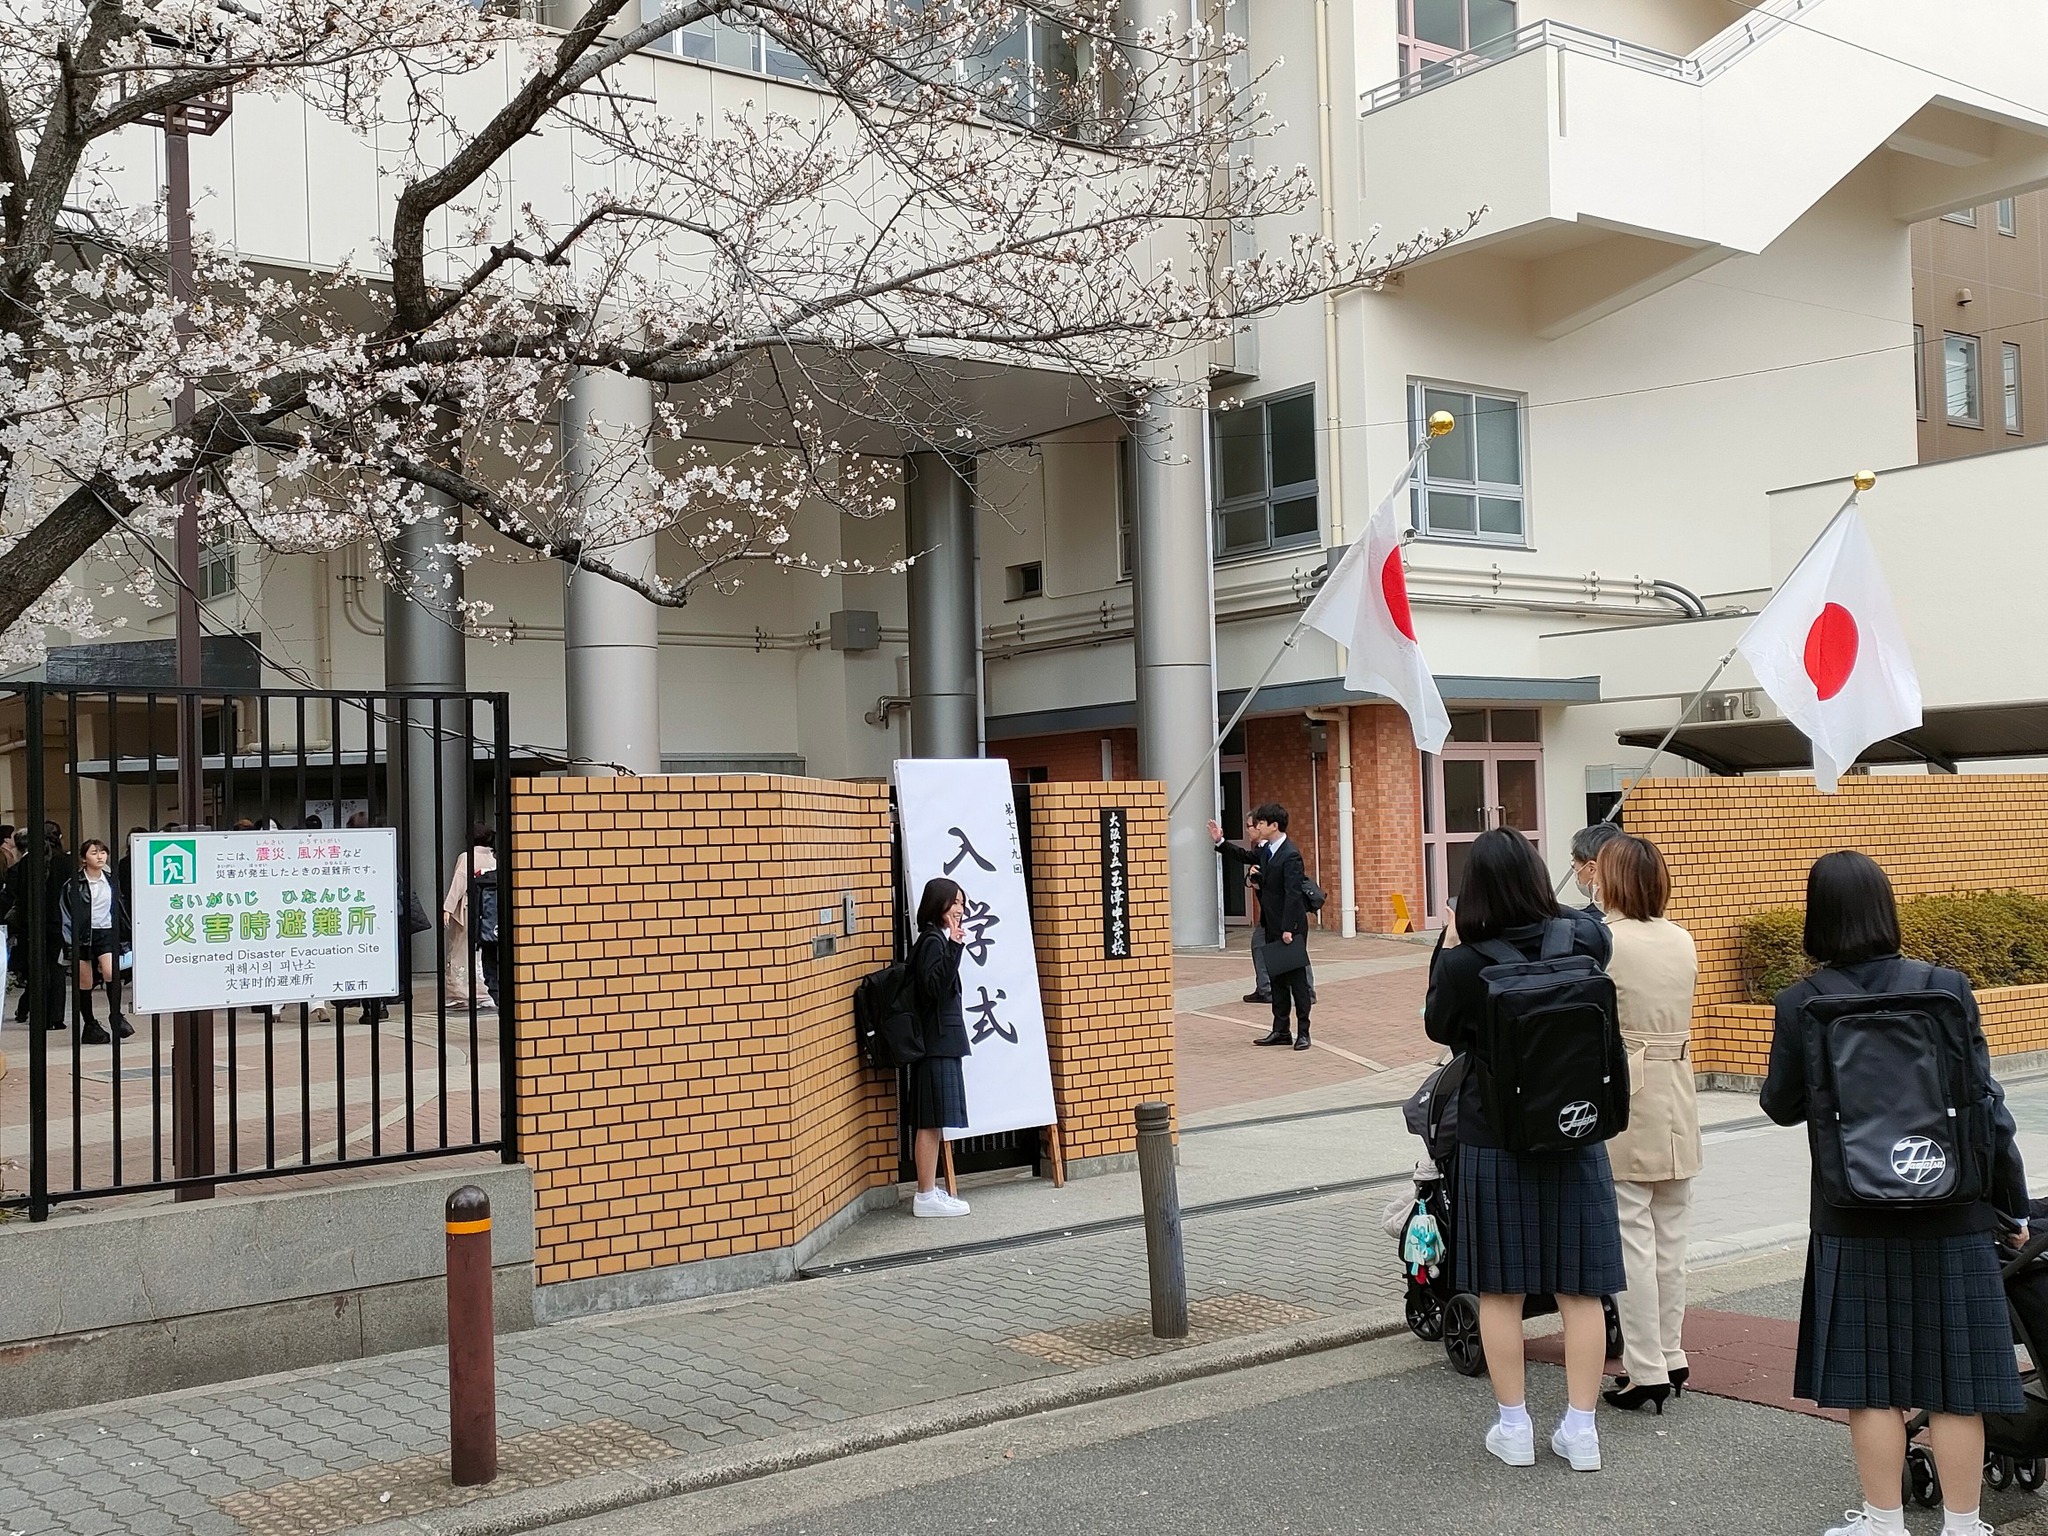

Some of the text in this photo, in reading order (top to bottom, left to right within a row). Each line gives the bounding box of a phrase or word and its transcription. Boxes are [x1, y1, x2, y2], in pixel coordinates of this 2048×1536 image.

[216, 845, 362, 862] ここは、震災、風水害など
[216, 865, 377, 880] 災害が発生したときの避難所です。
[1108, 811, 1127, 956] 大阪市立玉津中学校
[169, 886, 367, 910] さいがいじ ひなんじょ
[163, 904, 377, 946] 災害時避難所
[942, 826, 1019, 1045] 入学式
[165, 943, 380, 965] Designated Disaster Evacuation Site
[224, 959, 316, 975] 재해시의 피난소
[225, 973, 314, 991] 灾害时的避难所
[332, 980, 368, 992] 大阪市
